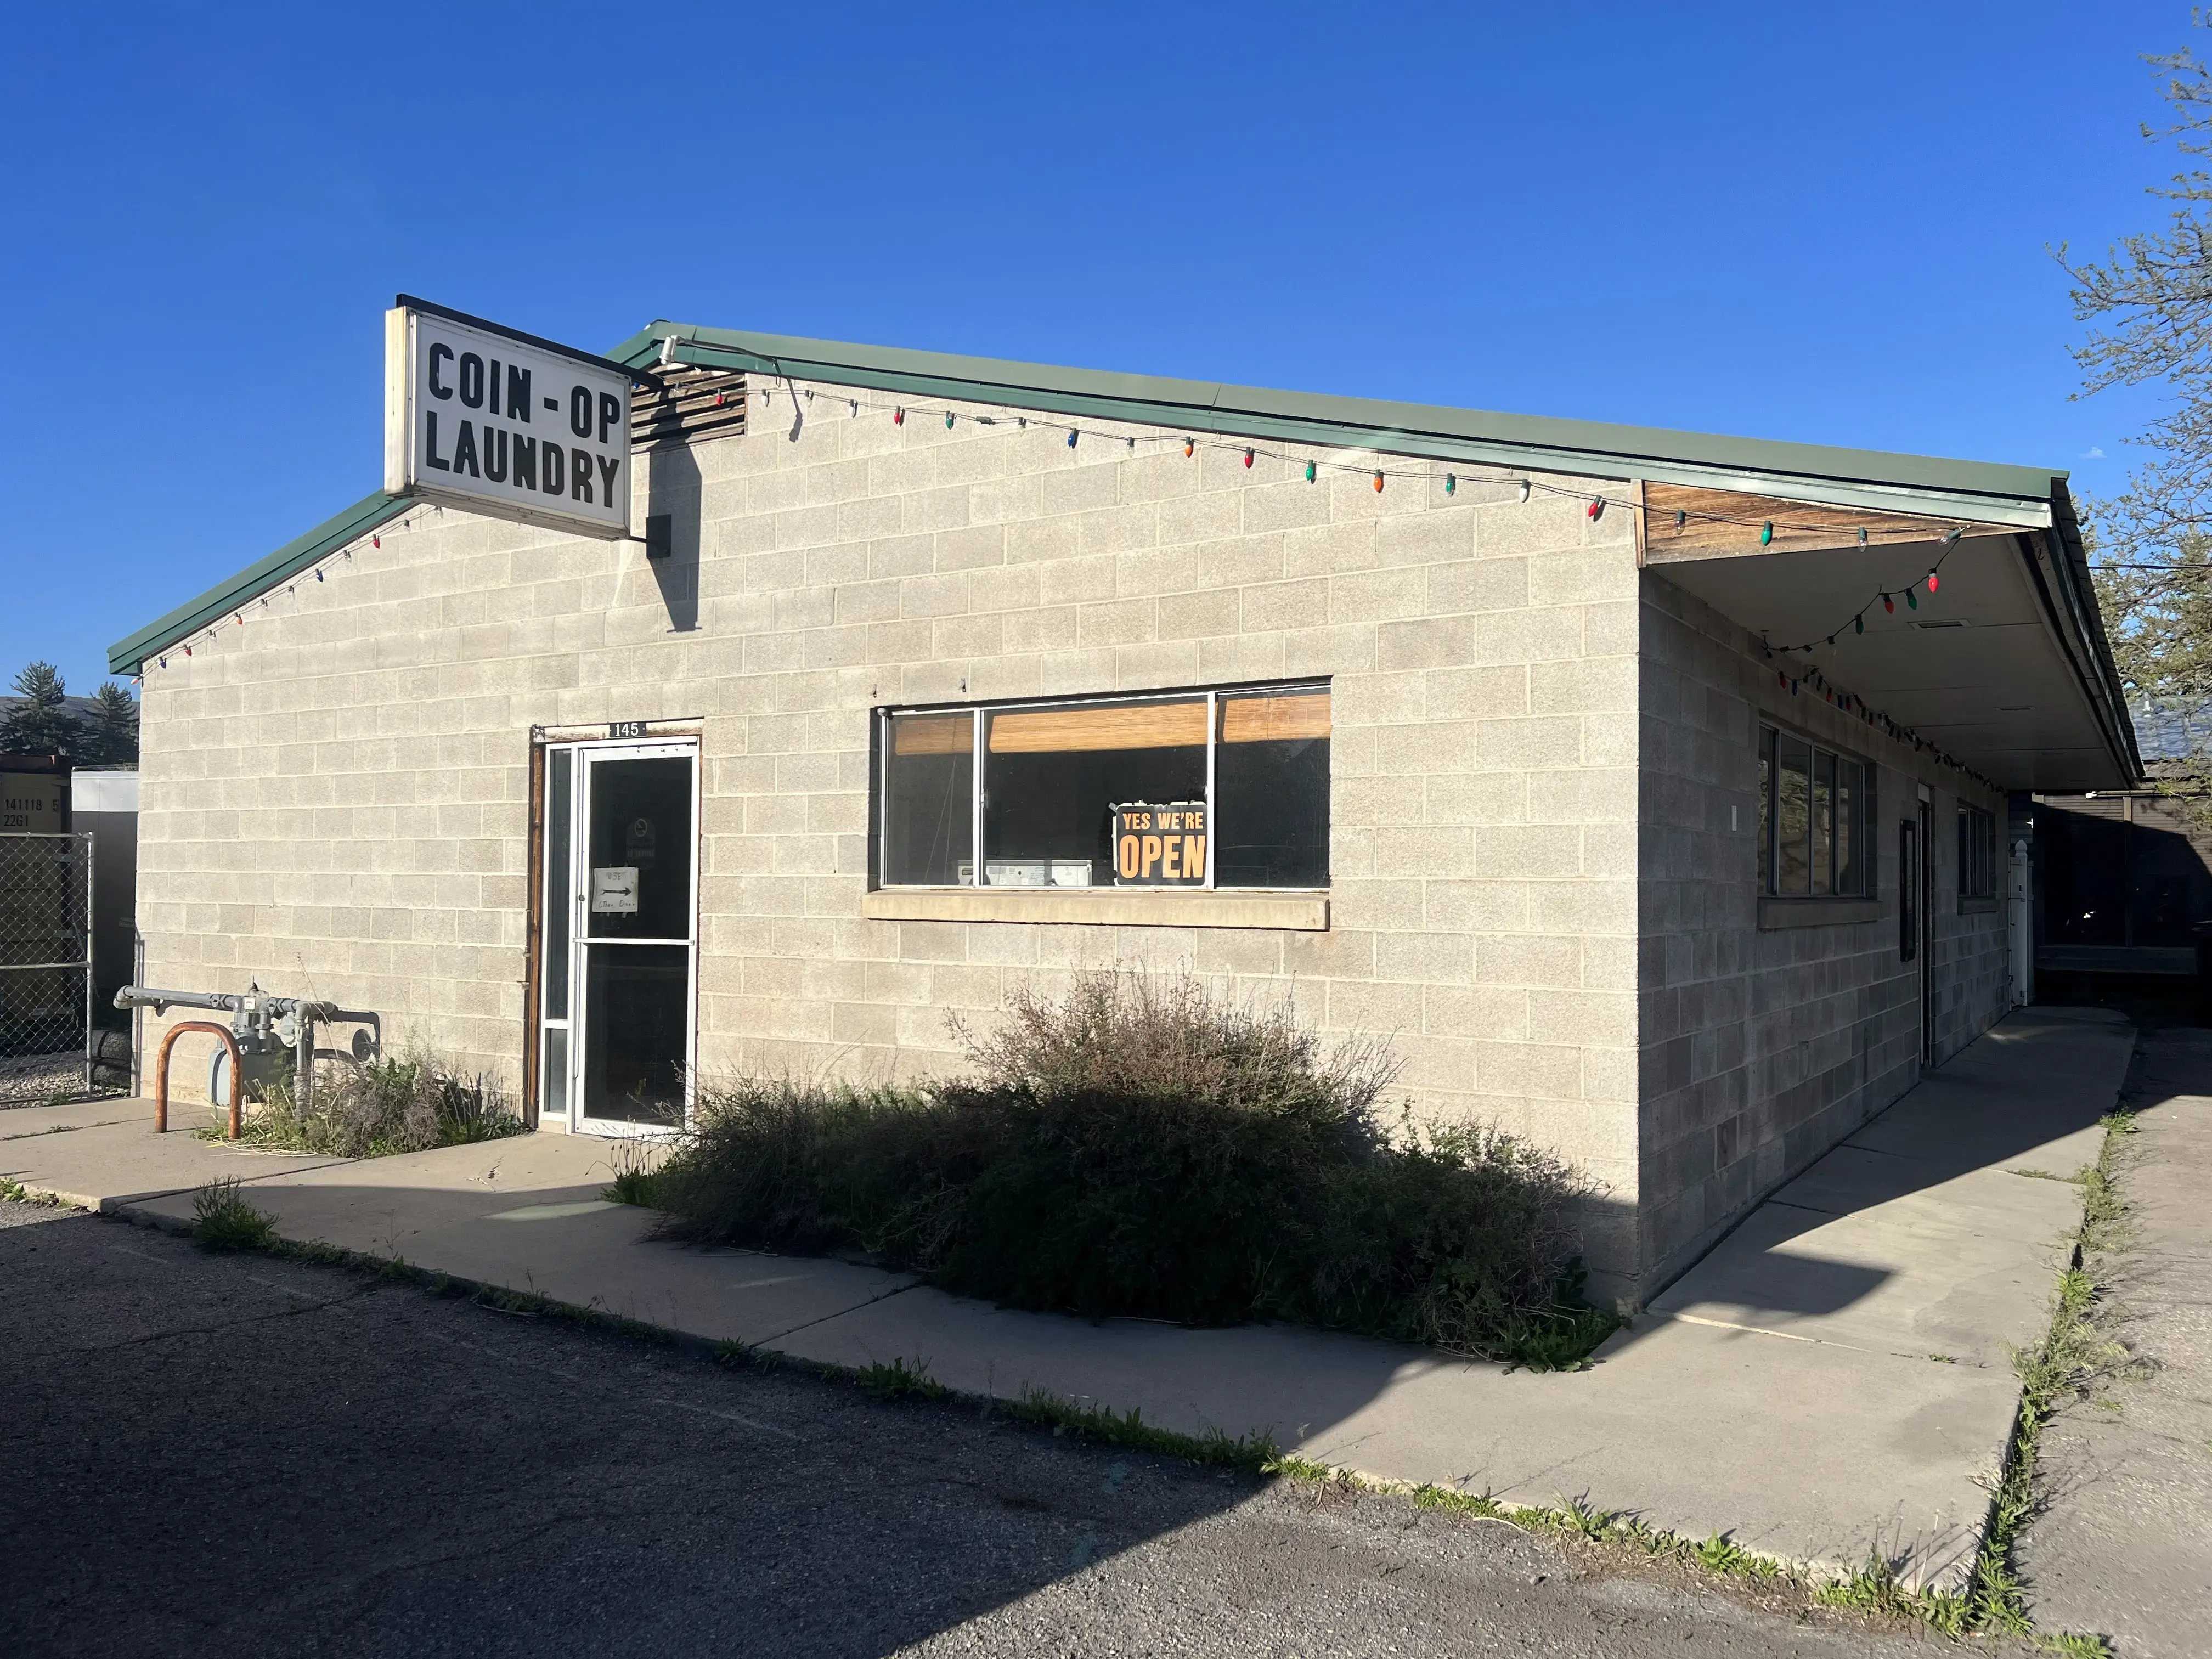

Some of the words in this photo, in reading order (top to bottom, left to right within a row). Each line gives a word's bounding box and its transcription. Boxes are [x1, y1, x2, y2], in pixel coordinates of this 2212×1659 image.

[426, 410, 620, 508] LAUNDRY
[616, 723, 639, 737] 145
[5, 798, 42, 811] 141118
[4, 814, 29, 827] 22G1
[1122, 812, 1151, 830] YES
[1158, 812, 1204, 830] WE'RE
[1120, 834, 1206, 879] OPEN
[607, 872, 622, 881] USE
